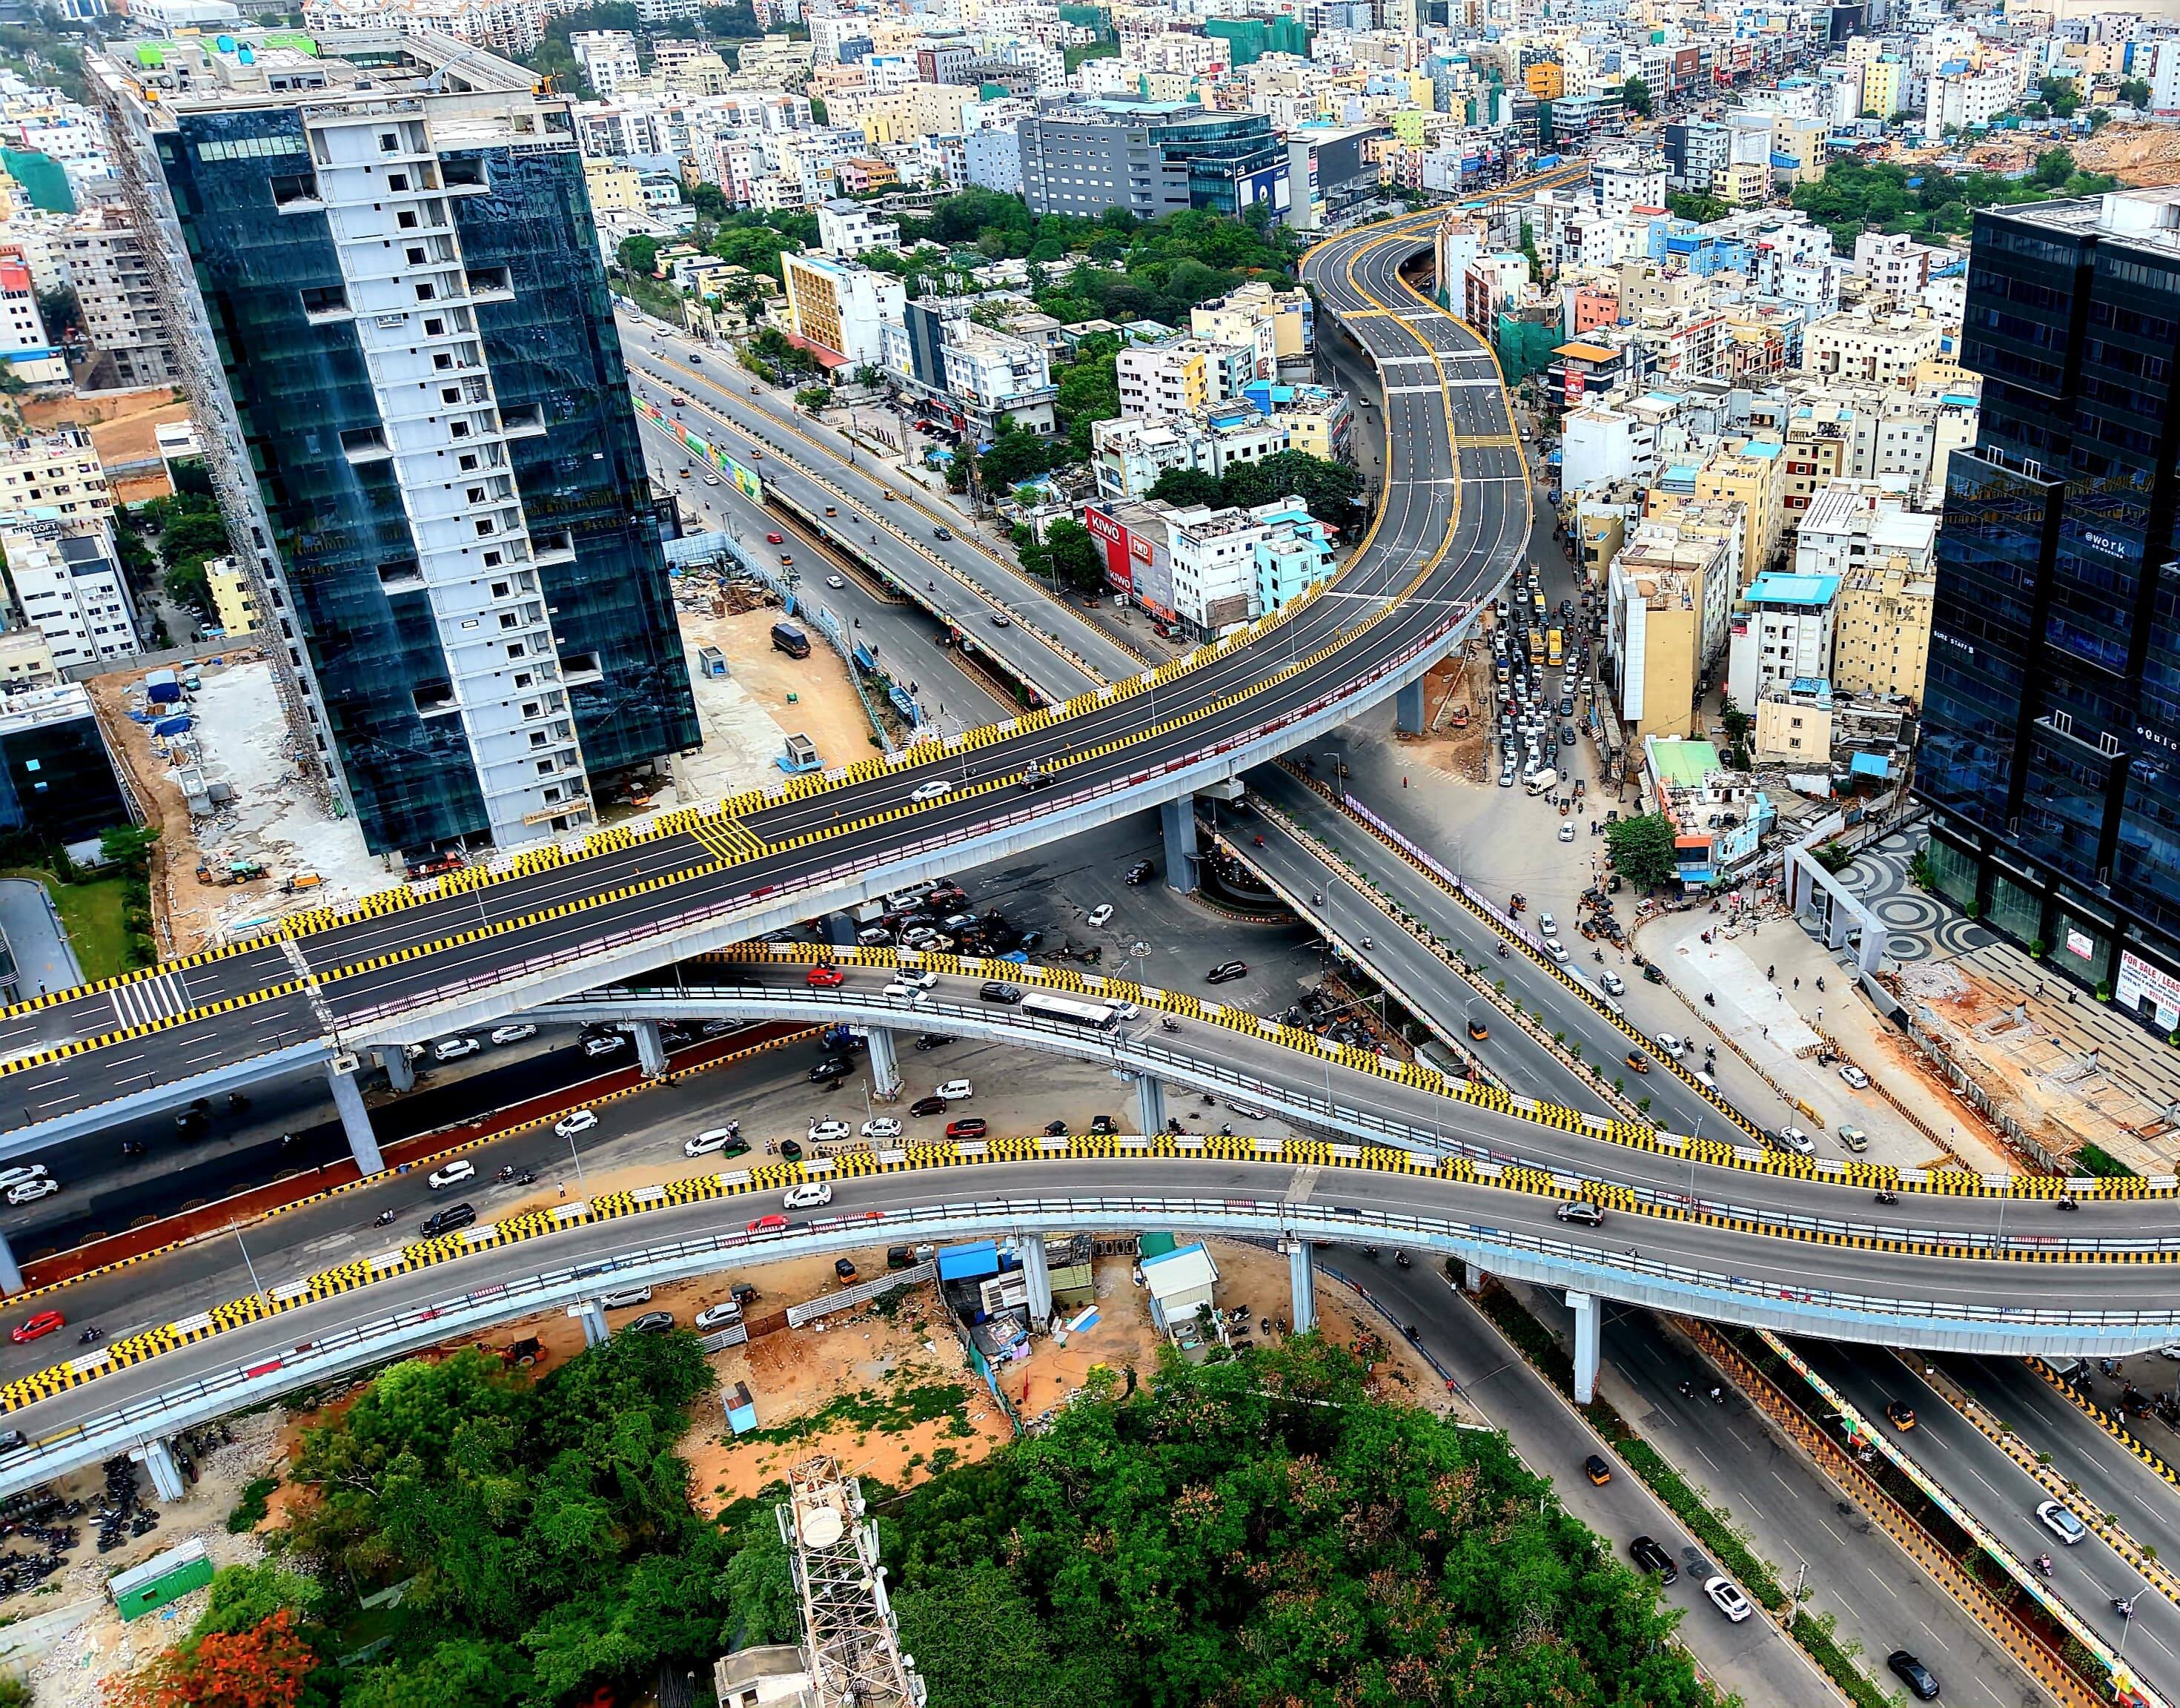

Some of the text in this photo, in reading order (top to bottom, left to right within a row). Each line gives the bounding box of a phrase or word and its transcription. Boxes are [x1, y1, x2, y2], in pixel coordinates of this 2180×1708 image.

[13, 522, 56, 534] NATSOFT
[1133, 538, 1148, 555] FWD
[2085, 532, 2125, 555] @work
[1933, 630, 1968, 650] SURE STAFF
[2123, 953, 2138, 967] FOR
[2138, 962, 2157, 979] SALE
